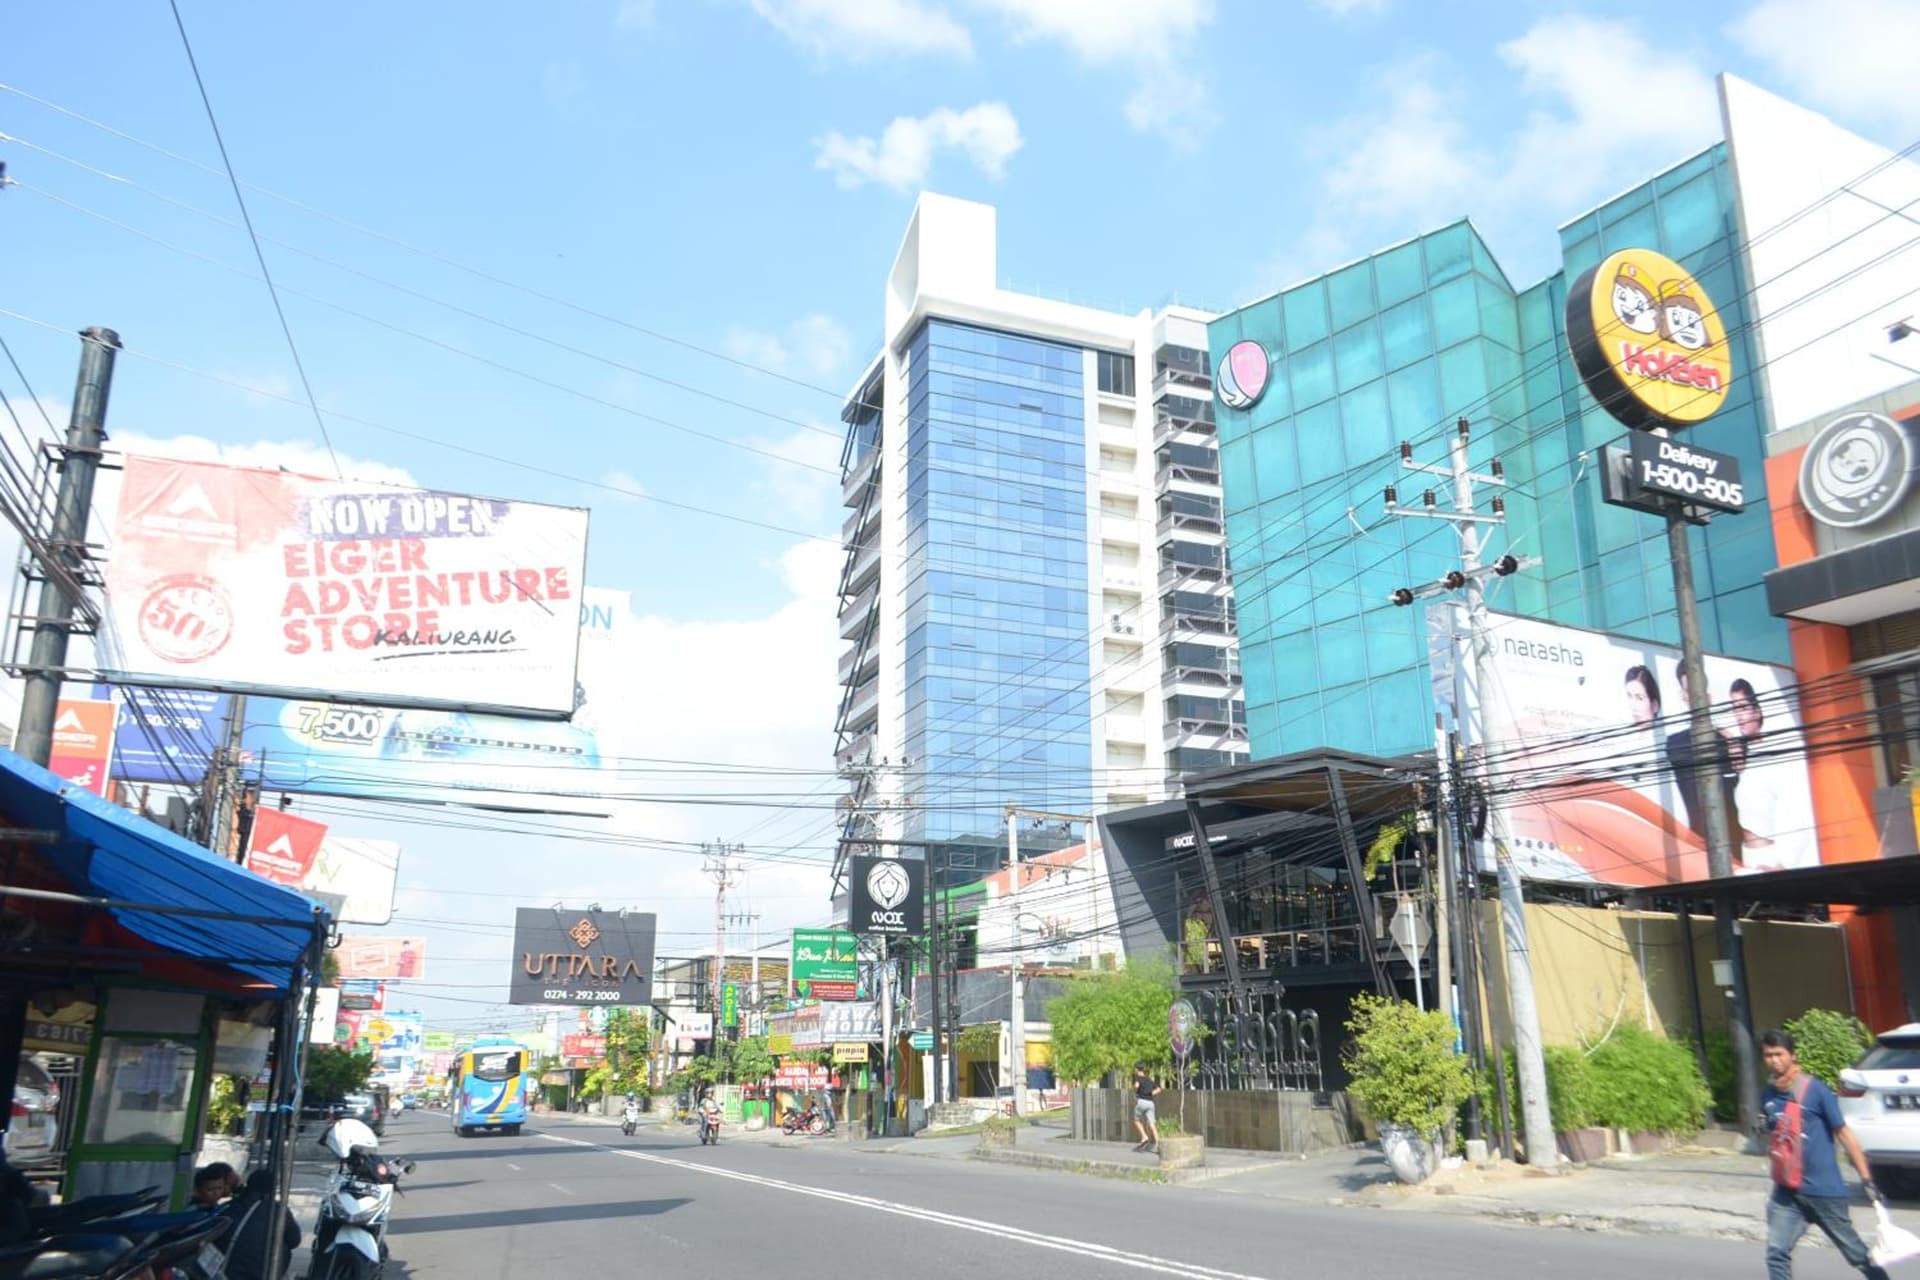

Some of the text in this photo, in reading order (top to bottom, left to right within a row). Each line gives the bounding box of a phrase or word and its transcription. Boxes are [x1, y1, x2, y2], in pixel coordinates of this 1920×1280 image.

[1620, 340, 1722, 394] HokBen
[1659, 442, 1718, 474] Delivery
[1642, 460, 1743, 505] 1-500-505
[308, 497, 496, 535] NOW OPEN
[283, 538, 429, 577] EIGER
[280, 566, 570, 617] ADVENTURE
[282, 610, 440, 654] STORE
[1504, 637, 1584, 667] natasha
[524, 952, 644, 979] UTTARA
[544, 990, 567, 1000] 0274
[575, 990, 592, 1000] 292
[595, 991, 620, 1001] 2000
